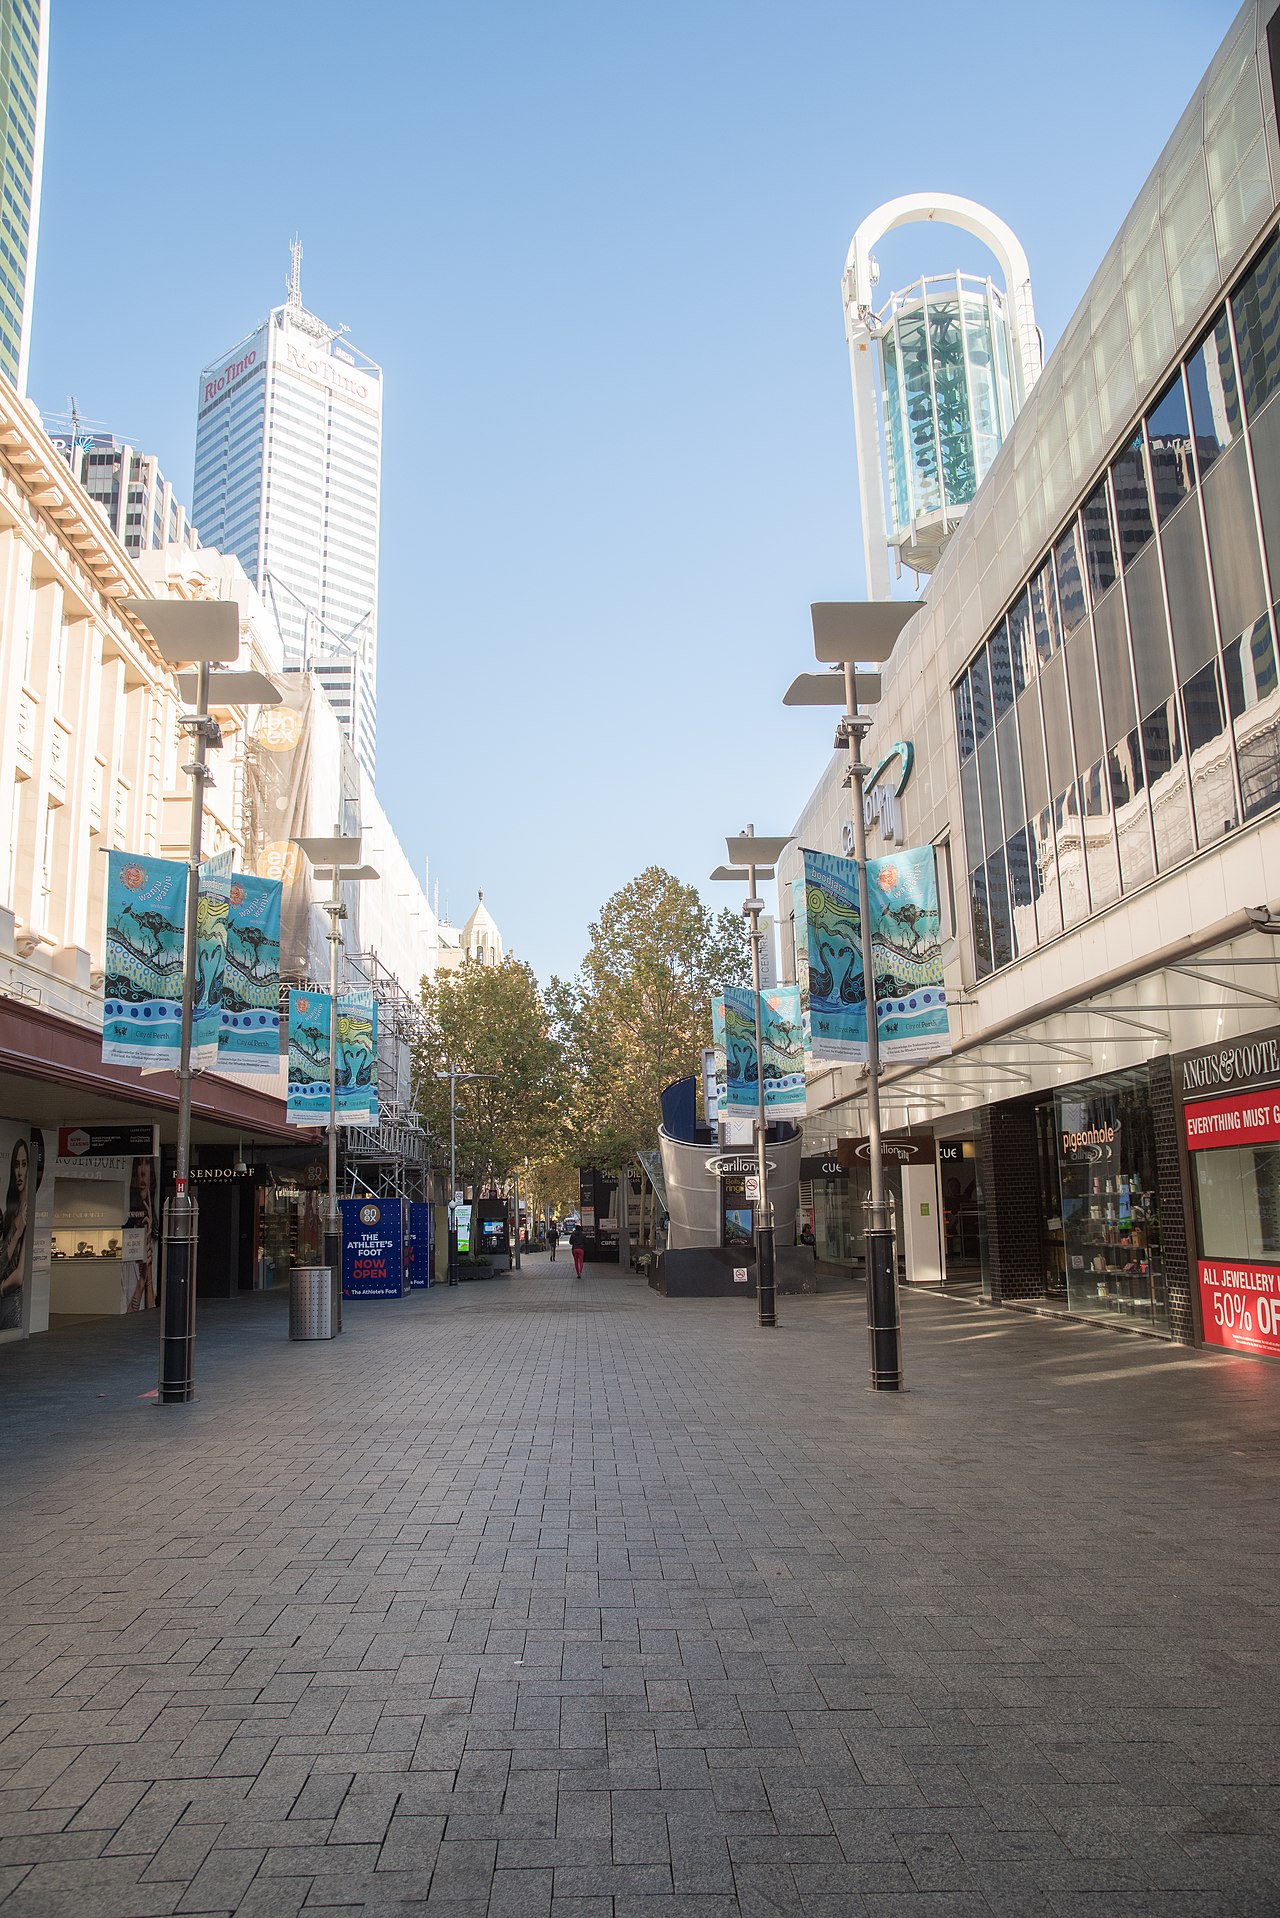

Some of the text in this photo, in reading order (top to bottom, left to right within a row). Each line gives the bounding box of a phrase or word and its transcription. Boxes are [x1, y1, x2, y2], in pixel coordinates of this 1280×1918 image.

[155, 875, 173, 902] wanju
[811, 866, 848, 895] boodjara
[138, 881, 162, 901] wanju
[239, 898, 260, 918] wanju
[253, 892, 271, 918] wanju
[760, 934, 770, 973] CENTRE
[921, 1020, 937, 1028] Perth
[136, 1031, 146, 1039] City
[1187, 1111, 1241, 1136] EVERYTHING
[1242, 1106, 1270, 1128] MUST
[1063, 1121, 1114, 1153] pigeonhole
[172, 1167, 255, 1179] RSENDORF
[715, 1157, 756, 1172] Carillon
[822, 1162, 843, 1173] CUE
[178, 1183, 184, 1192] H
[364, 1208, 377, 1217] en
[347, 1241, 393, 1249] ATHLETE'S
[354, 1259, 386, 1269] NOW
[352, 1269, 387, 1279] OPEN
[1203, 1268, 1219, 1286] ALL
[1221, 1270, 1274, 1292] JEWELLERY
[1213, 1291, 1253, 1331] 50%
